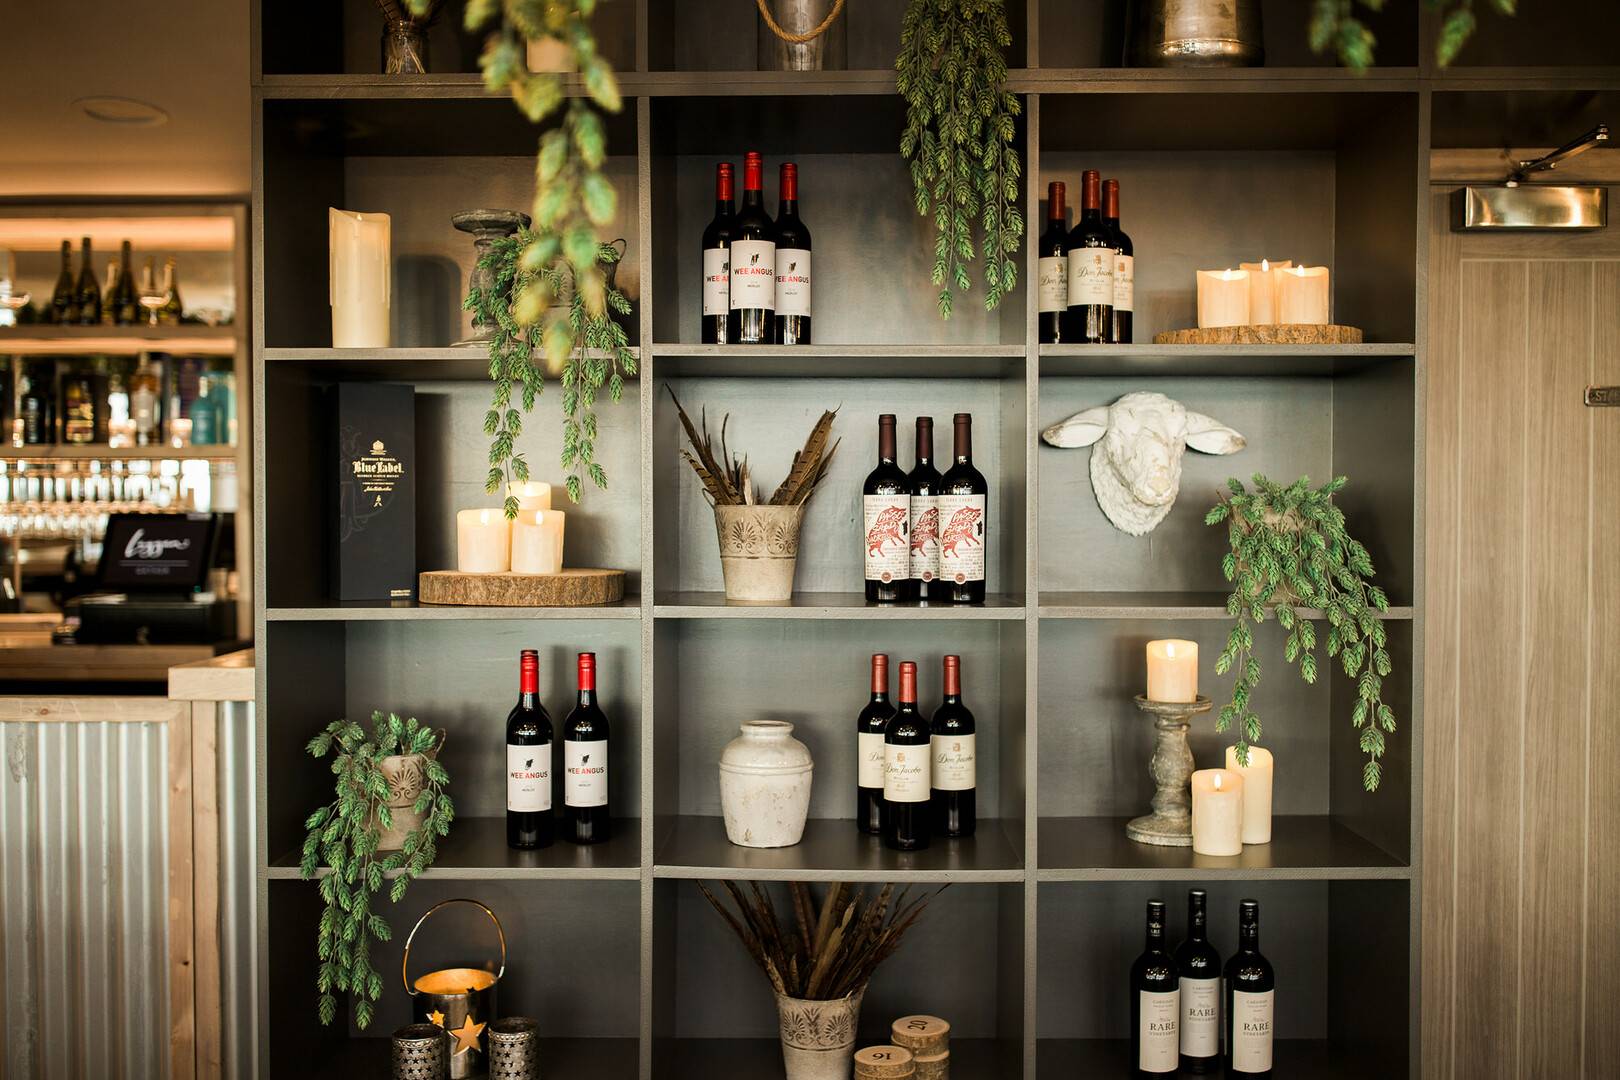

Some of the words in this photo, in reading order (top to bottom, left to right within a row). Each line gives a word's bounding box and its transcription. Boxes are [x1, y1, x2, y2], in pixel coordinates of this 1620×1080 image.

[734, 268, 749, 276] WEE
[751, 268, 773, 276] ANGUS
[788, 275, 809, 284] ANGUS
[352, 460, 376, 474] Blue
[376, 461, 403, 474] Label
[511, 771, 524, 779] WEE
[525, 771, 548, 779] ANGUS
[568, 767, 580, 775] WEE
[581, 766, 605, 775] ANGUS
[1189, 1008, 1216, 1017] RARE
[907, 1020, 928, 1031] 20
[1150, 1021, 1175, 1032] RARE
[1243, 1022, 1269, 1032] RARE
